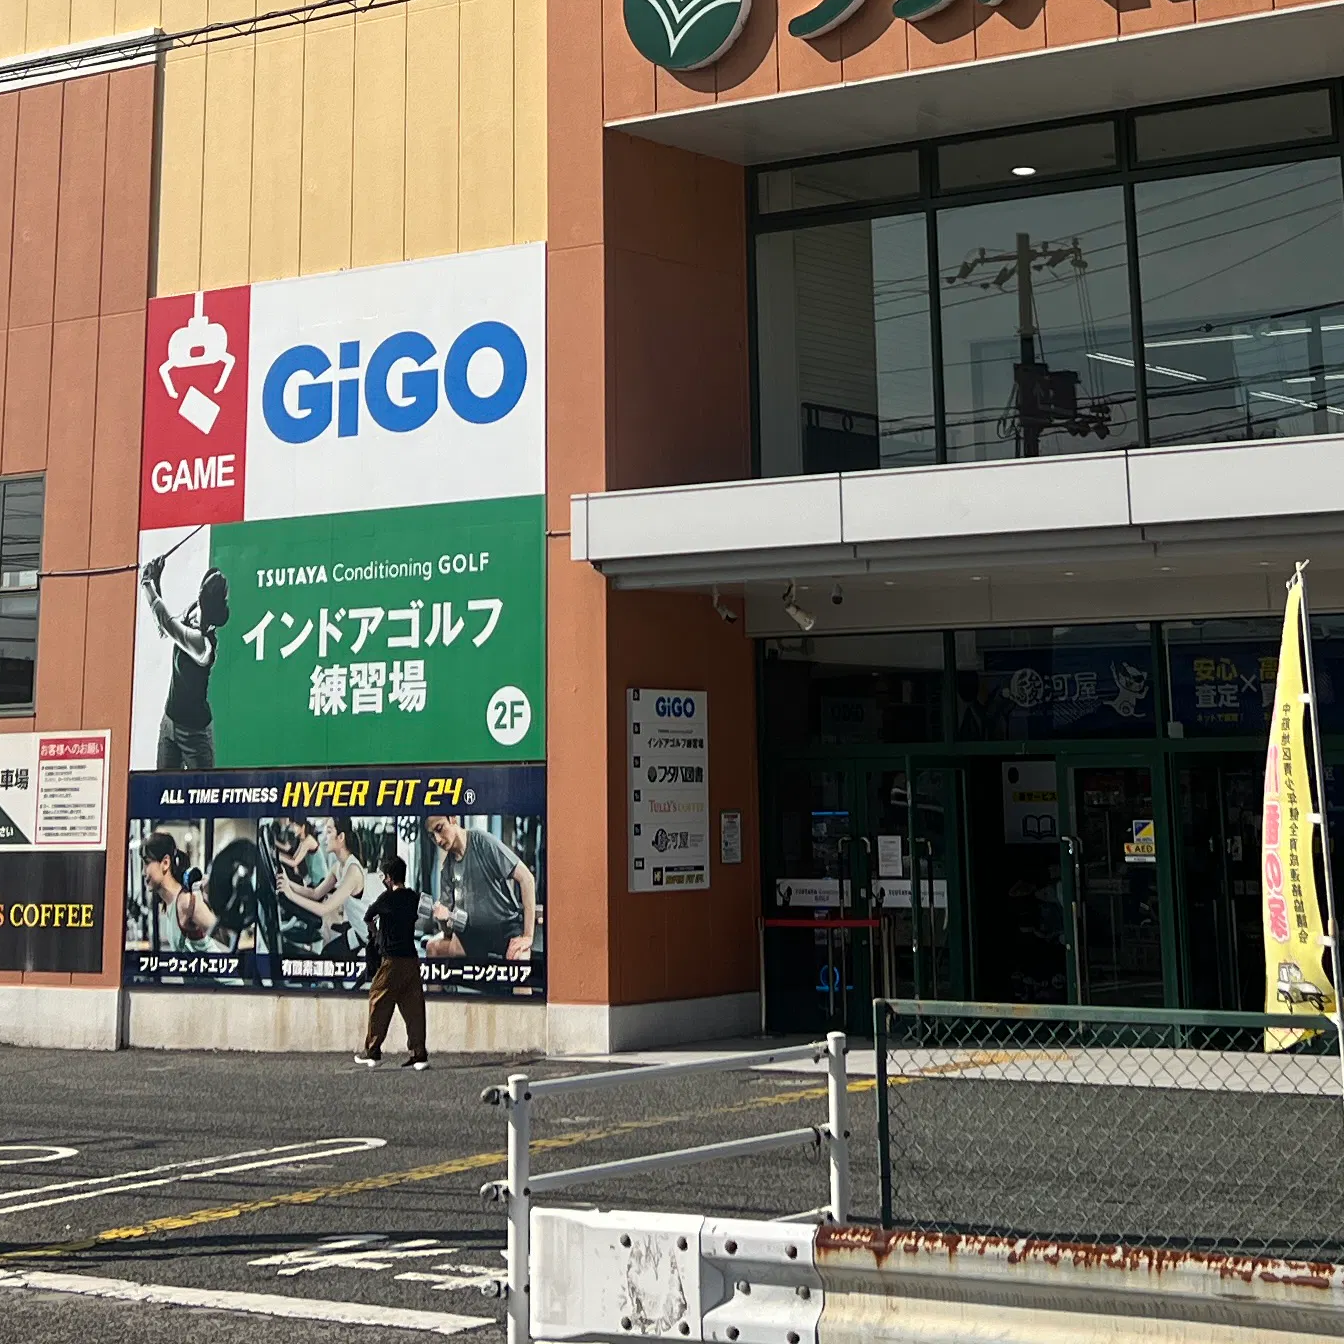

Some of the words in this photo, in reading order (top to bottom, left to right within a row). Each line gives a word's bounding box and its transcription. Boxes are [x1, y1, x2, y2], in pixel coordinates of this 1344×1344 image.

[262, 320, 528, 444] GiGO
[151, 454, 236, 494] GAME
[256, 565, 329, 588] TSUTAYA
[332, 560, 433, 583] Conditioning
[438, 552, 490, 574] GOLF
[242, 598, 505, 662] インドアゴルフ
[308, 659, 429, 717] 練習場
[493, 699, 526, 731] 2F
[655, 696, 695, 718] GiGO
[159, 788, 185, 806] ALL
[187, 788, 220, 804] TIME
[221, 787, 278, 804] FITNESS
[281, 779, 370, 808] HYPER
[376, 778, 421, 807] FIT
[423, 777, 464, 806] 24
[1134, 844, 1154, 854] AED
[9, 903, 95, 928] COFFEE
[139, 956, 240, 974] フリーウェイトエリア
